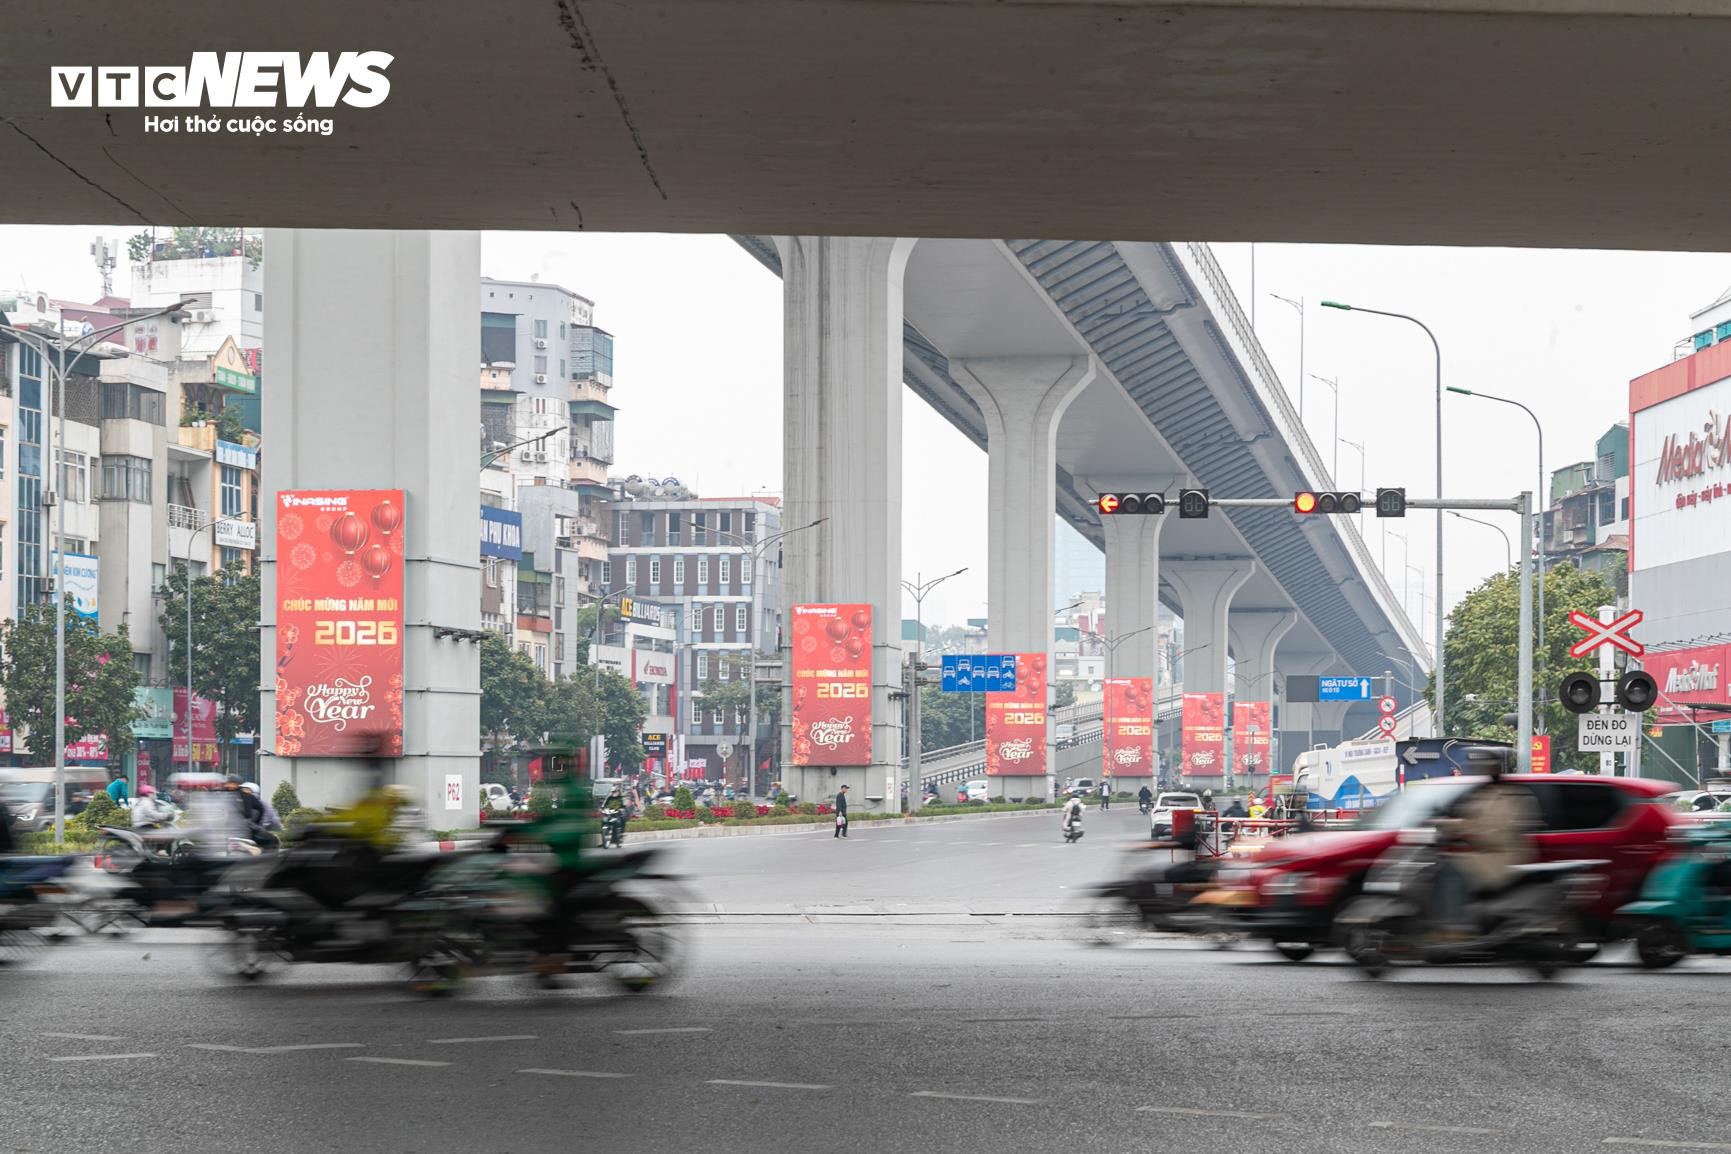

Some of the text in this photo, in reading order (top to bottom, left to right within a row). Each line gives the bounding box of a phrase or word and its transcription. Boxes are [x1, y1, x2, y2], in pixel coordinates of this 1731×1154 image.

[283, 597, 312, 612] CHÚC
[314, 596, 346, 612] MỪNG
[349, 596, 375, 612] NĂM
[620, 597, 633, 617] ACE
[315, 621, 398, 645] 2026
[817, 683, 869, 698] 2026
[337, 695, 364, 706] New
[310, 697, 376, 724] Year
[1004, 712, 1044, 725] 2026
[1586, 716, 1627, 730] ĐÈN ĐỎ
[814, 729, 855, 746] Year
[1118, 725, 1151, 736] 2026
[1195, 733, 1222, 742] 2026
[1583, 732, 1631, 748] DỪNG LẠI
[1002, 748, 1034, 760] Year
[447, 783, 460, 801] P62
